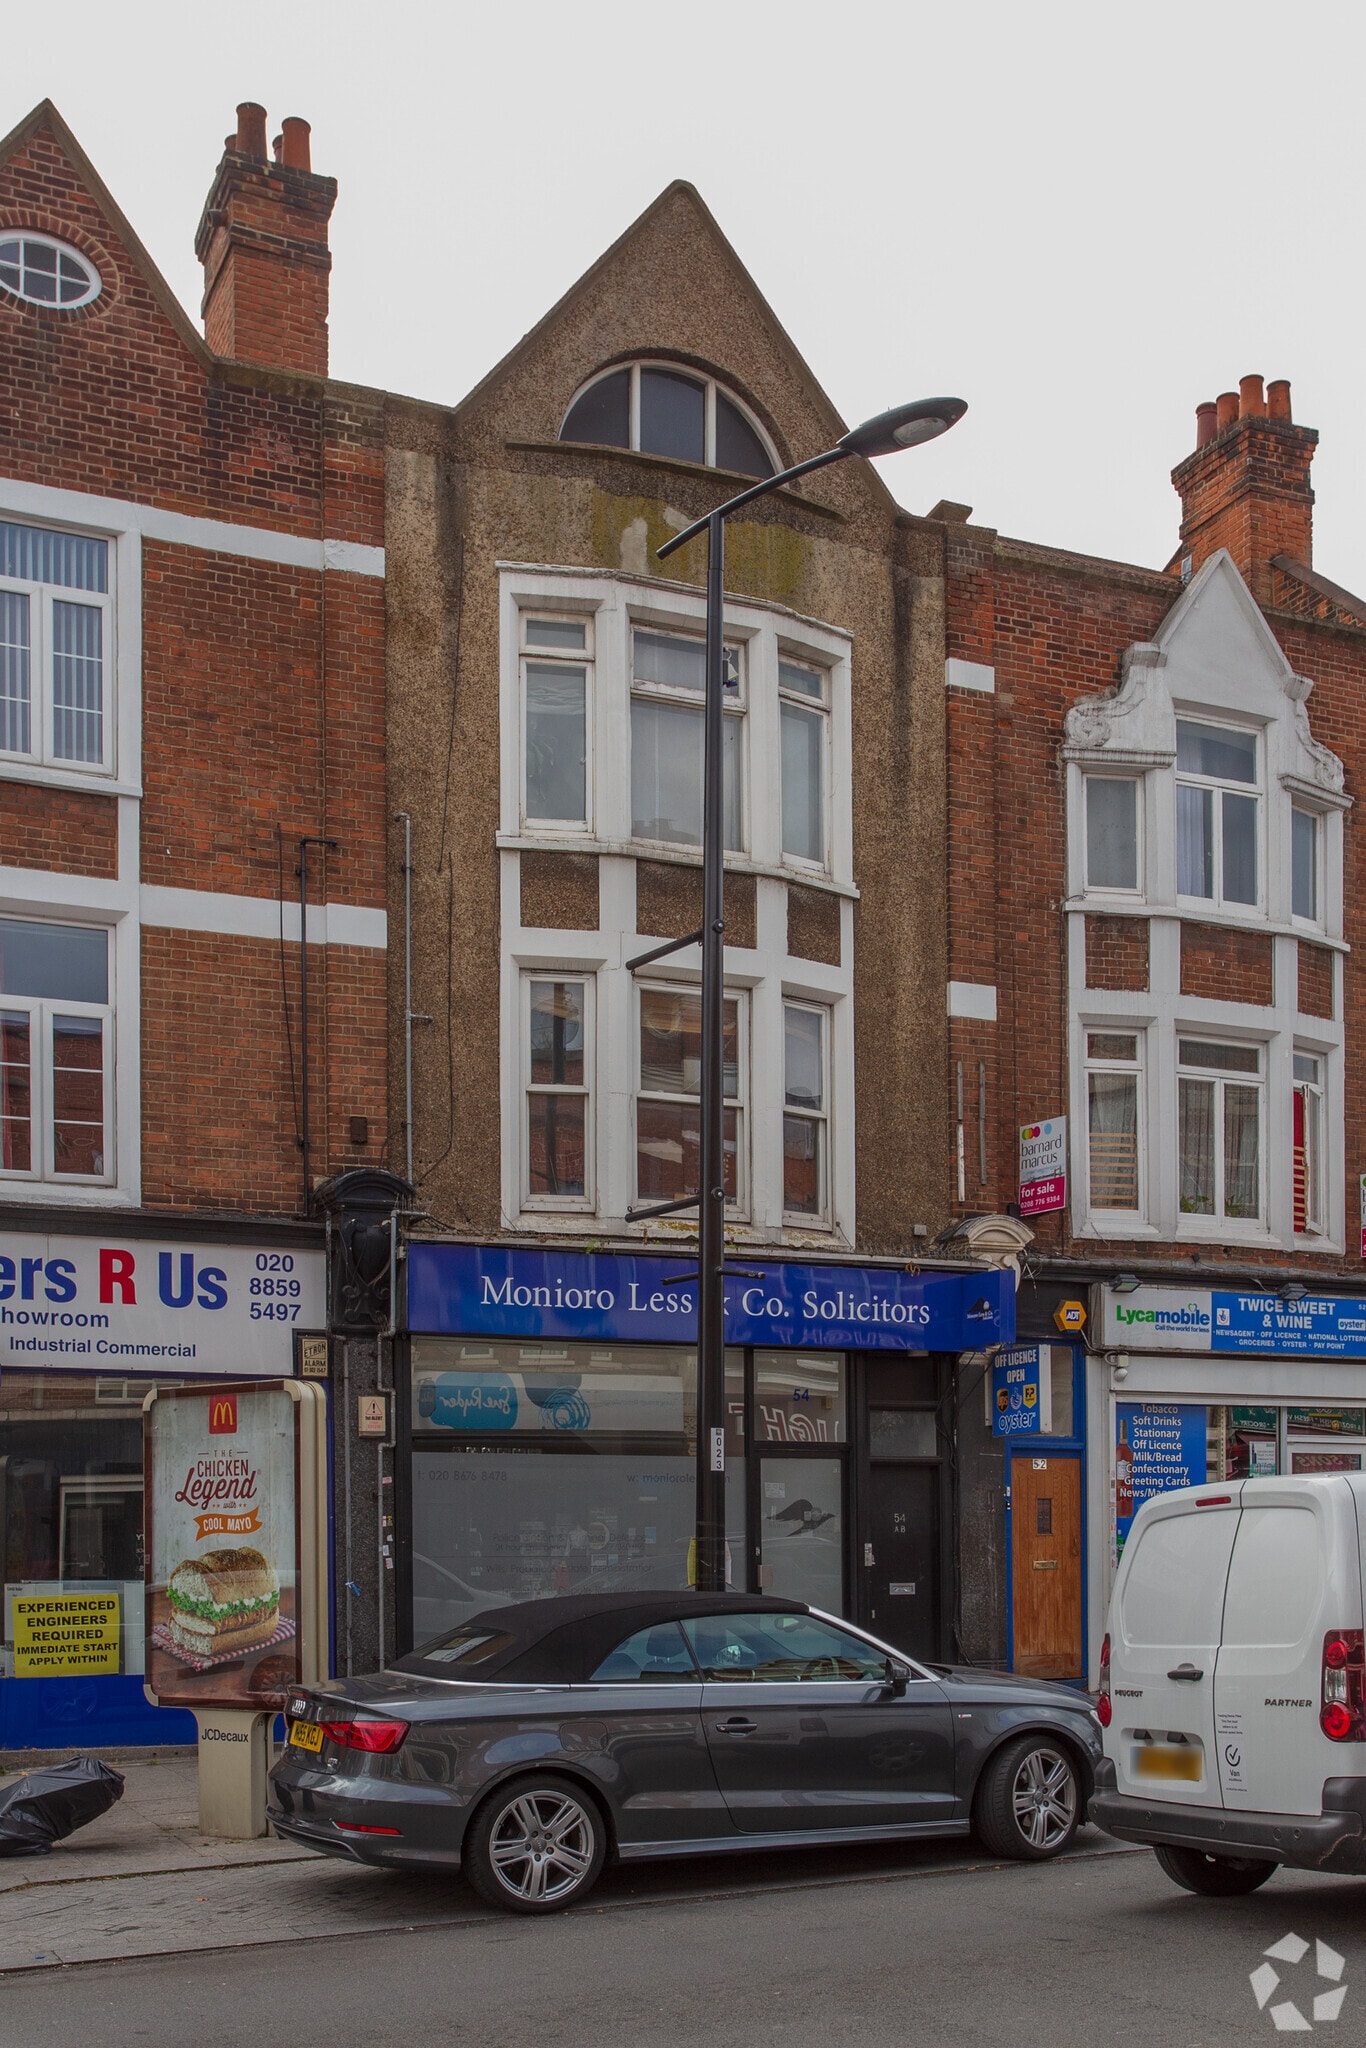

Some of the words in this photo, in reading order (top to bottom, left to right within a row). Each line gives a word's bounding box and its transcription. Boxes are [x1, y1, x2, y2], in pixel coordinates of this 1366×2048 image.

[1021, 1133, 1062, 1157] barnard
[1021, 1152, 1058, 1170] marcus
[1021, 1186, 1035, 1198] for
[1037, 1181, 1055, 1196] sale
[255, 1253, 294, 1273] 020
[99, 1248, 138, 1305] R
[158, 1251, 228, 1311] Us
[249, 1277, 301, 1297] 8859
[480, 1275, 615, 1310] Monioro
[628, 1282, 693, 1314] Less
[742, 1288, 790, 1318] Co.
[802, 1290, 931, 1324] Solicitors
[249, 1301, 302, 1322] 5497
[1238, 1297, 1283, 1313] TWICE
[1288, 1299, 1336, 1316] SWEET
[1, 1306, 109, 1328] howroom
[1066, 1309, 1081, 1322] ADT
[1116, 1303, 1210, 1326] Lycamobile
[1262, 1314, 1272, 1328] &
[1276, 1315, 1313, 1330] WINE
[1339, 1320, 1364, 1330] oyster
[1215, 1329, 1255, 1338] NEWSAGENT
[1274, 1331, 1302, 1340] LICENCE
[1308, 1333, 1338, 1341] NATIONAL
[10, 1336, 91, 1353] Industrial
[96, 1340, 196, 1358] Commercial
[304, 1343, 326, 1358] ETRON
[1238, 1339, 1276, 1347] GROCERIES
[1326, 1342, 1345, 1350] POINT
[994, 1353, 1007, 1368] OFF
[1008, 1349, 1037, 1366] LICENCE
[1006, 1368, 1025, 1383] OPEN
[792, 1388, 810, 1402] 54
[1141, 1404, 1179, 1414] Tobacco
[998, 1410, 1035, 1434] oyster
[1132, 1416, 1151, 1426] Soft
[1153, 1416, 1182, 1426] Drinks
[1134, 1428, 1181, 1440] Stationary
[1132, 1440, 1147, 1449] Off
[1149, 1440, 1182, 1450] Licence
[214, 1449, 233, 1458] THE
[1133, 1451, 1182, 1462] Milk/Bread
[197, 1459, 249, 1478] CHICKEN
[1033, 1459, 1046, 1469] 52
[1126, 1464, 1189, 1475] Confectionary
[1124, 1476, 1163, 1488] Greeting
[1165, 1476, 1191, 1486] Cards
[175, 1467, 258, 1511] Legend
[223, 1501, 237, 1509] with
[203, 1517, 224, 1532] COOL
[227, 1516, 252, 1531] MAYO
[893, 1513, 906, 1523] 54
[18, 1600, 116, 1613] EXPERIENCED
[27, 1614, 108, 1627] ENGINEERS
[32, 1629, 104, 1641] REQUIRED
[17, 1644, 80, 1655] IMMEDIATE
[83, 1642, 118, 1652] START
[28, 1656, 64, 1666] APPLY
[67, 1654, 108, 1664] WITHIN
[1114, 1689, 1143, 1698] PEUGEOT
[1264, 1698, 1312, 1708] PARTNER
[201, 1728, 249, 1743] JCDecaux
[1229, 1768, 1240, 1777] Van
